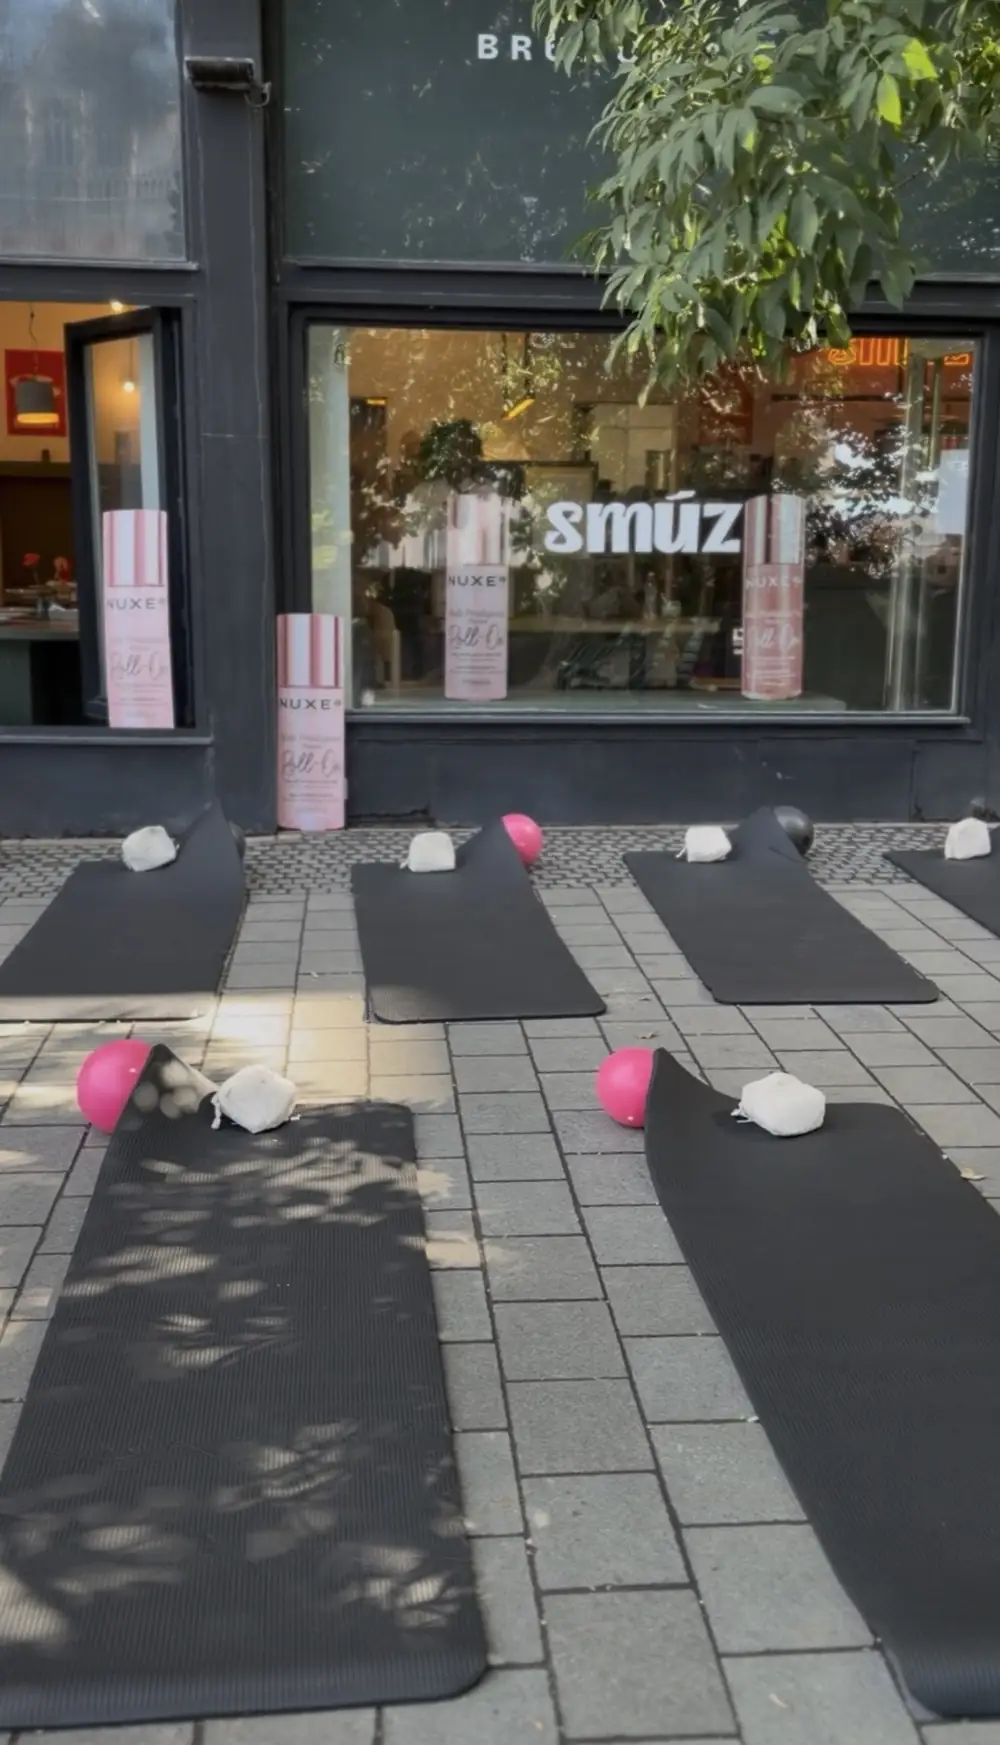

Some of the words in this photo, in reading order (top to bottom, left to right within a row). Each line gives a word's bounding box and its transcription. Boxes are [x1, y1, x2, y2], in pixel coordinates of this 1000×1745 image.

[544, 489, 743, 555] smúz
[448, 575, 497, 588] NUXE
[106, 597, 157, 611] NUXE
[279, 698, 331, 711] NUXE
